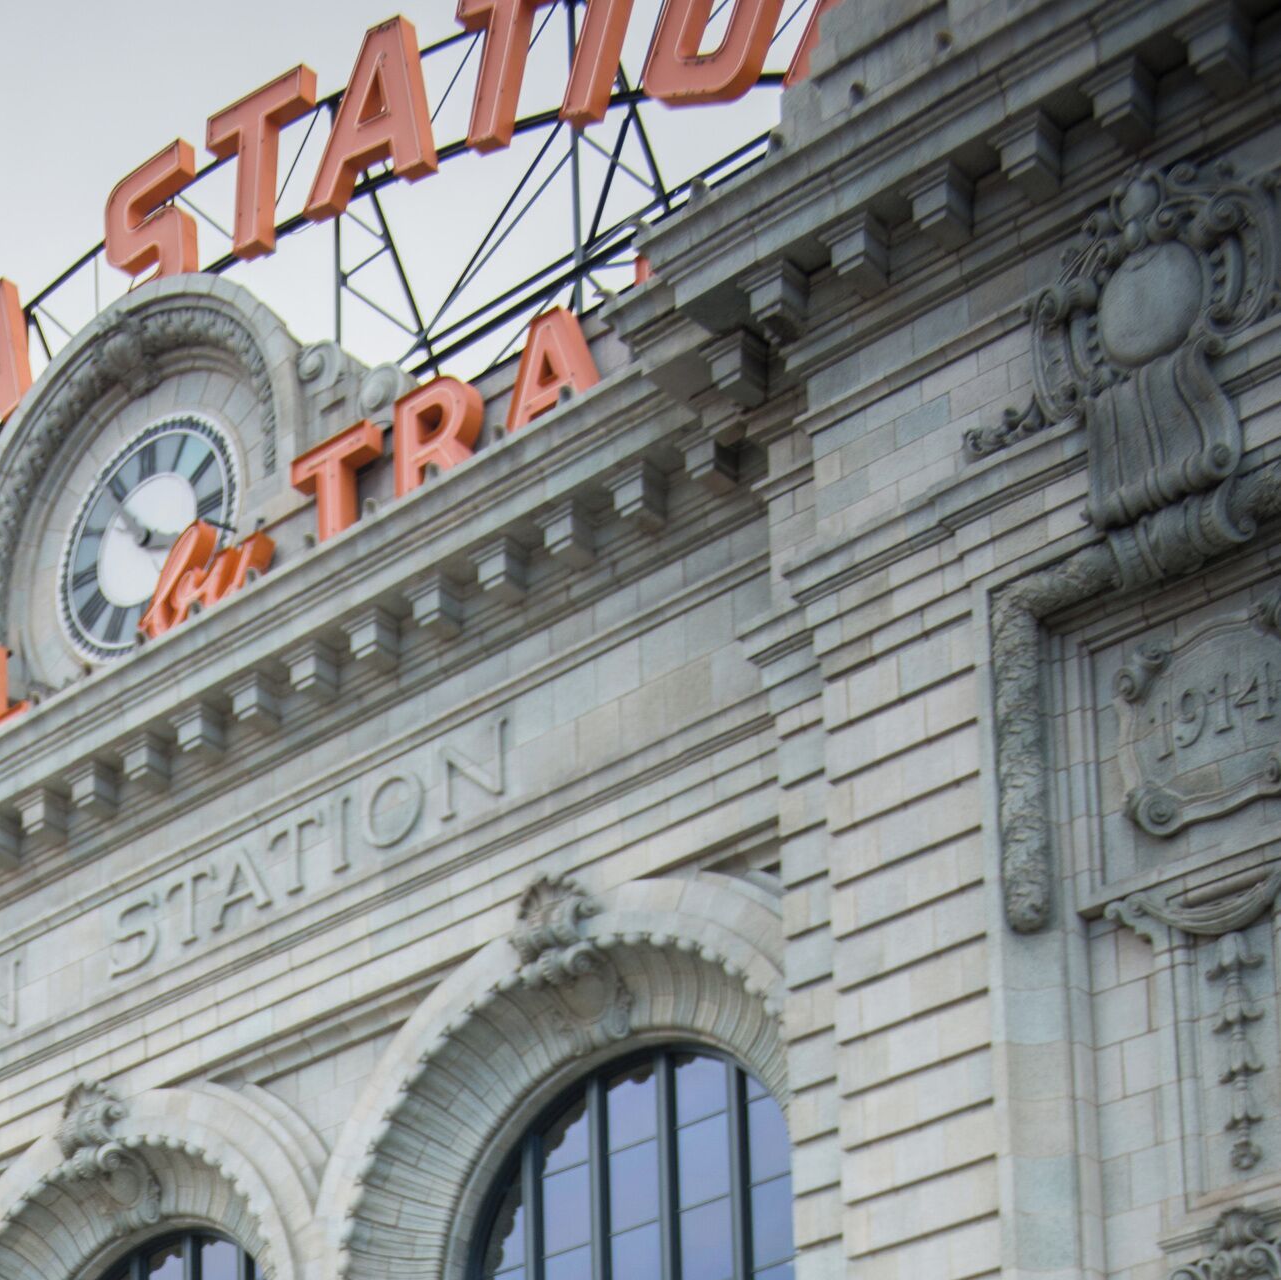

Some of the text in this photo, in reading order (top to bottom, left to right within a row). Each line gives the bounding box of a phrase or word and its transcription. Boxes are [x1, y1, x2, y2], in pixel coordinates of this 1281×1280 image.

[101, 0, 839, 290] STATIO
[290, 256, 653, 542] TRA
[107, 716, 509, 979] STATION
[1149, 660, 1278, 762] 1914
